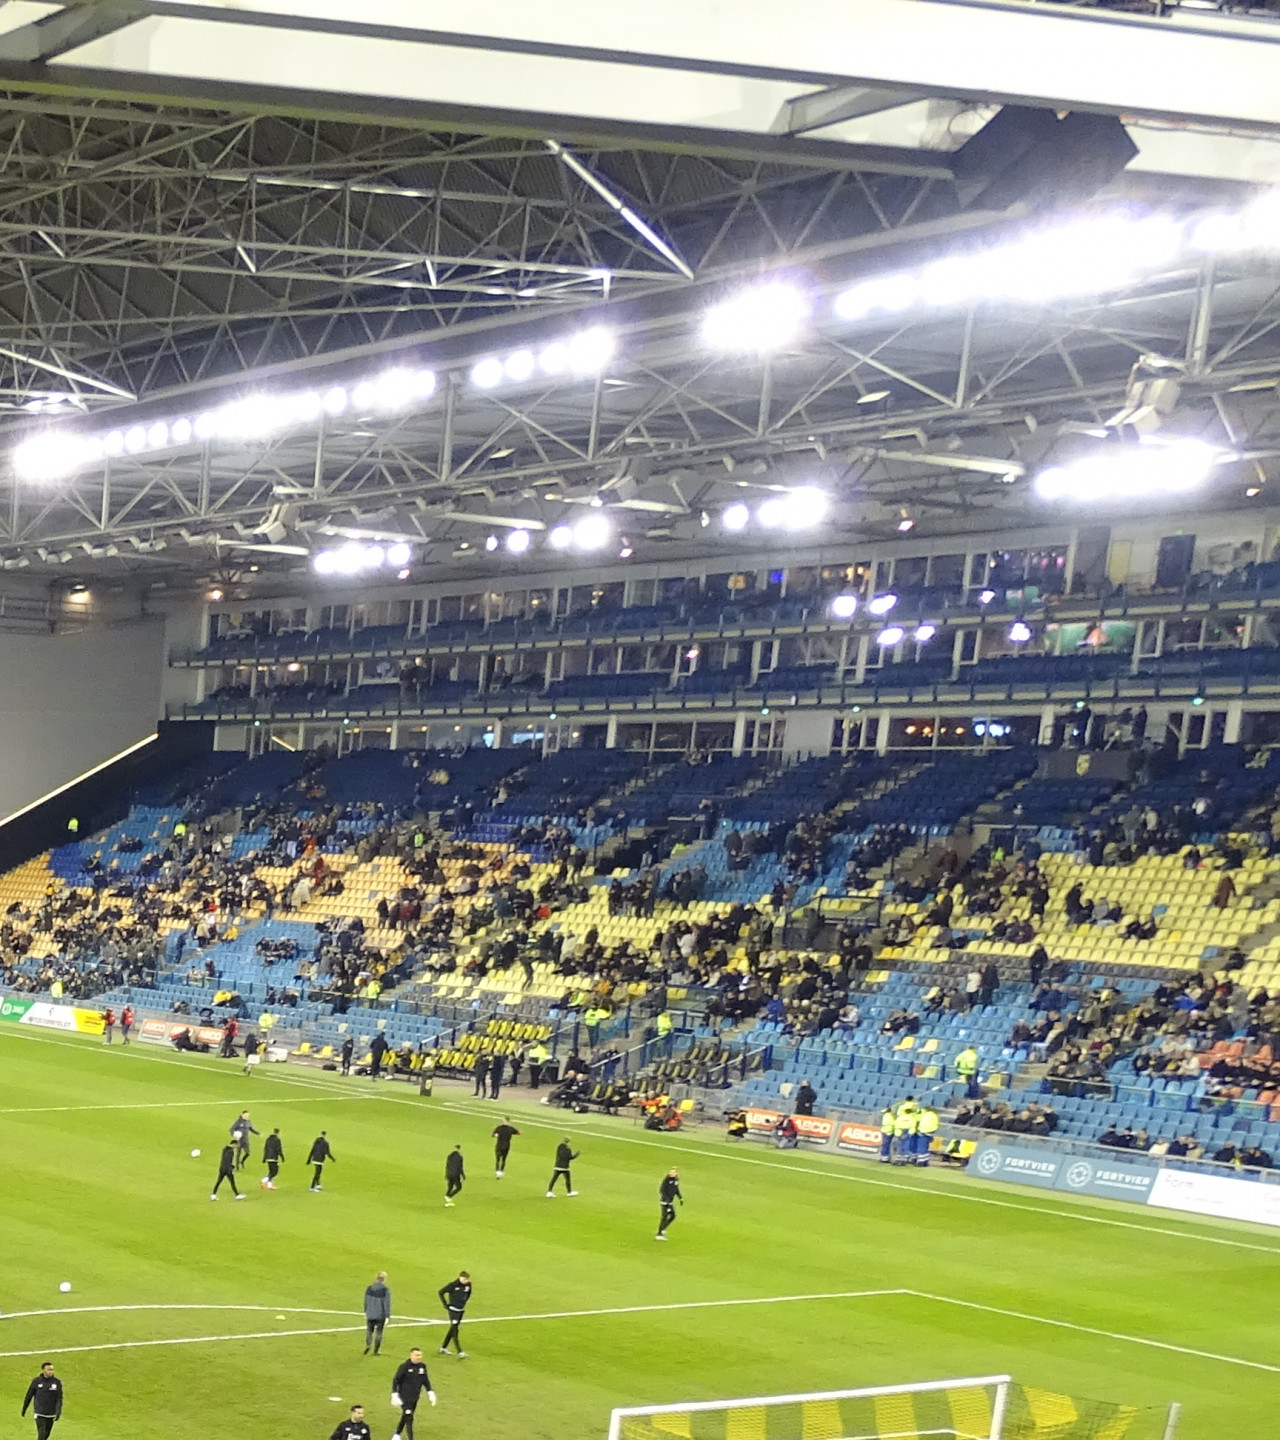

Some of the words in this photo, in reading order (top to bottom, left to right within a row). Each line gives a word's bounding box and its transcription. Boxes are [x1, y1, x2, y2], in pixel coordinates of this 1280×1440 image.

[841, 1127, 882, 1143] ABCO
[1005, 1157, 1057, 1172] FORTVIER
[1096, 1170, 1151, 1185] FORTVIER
